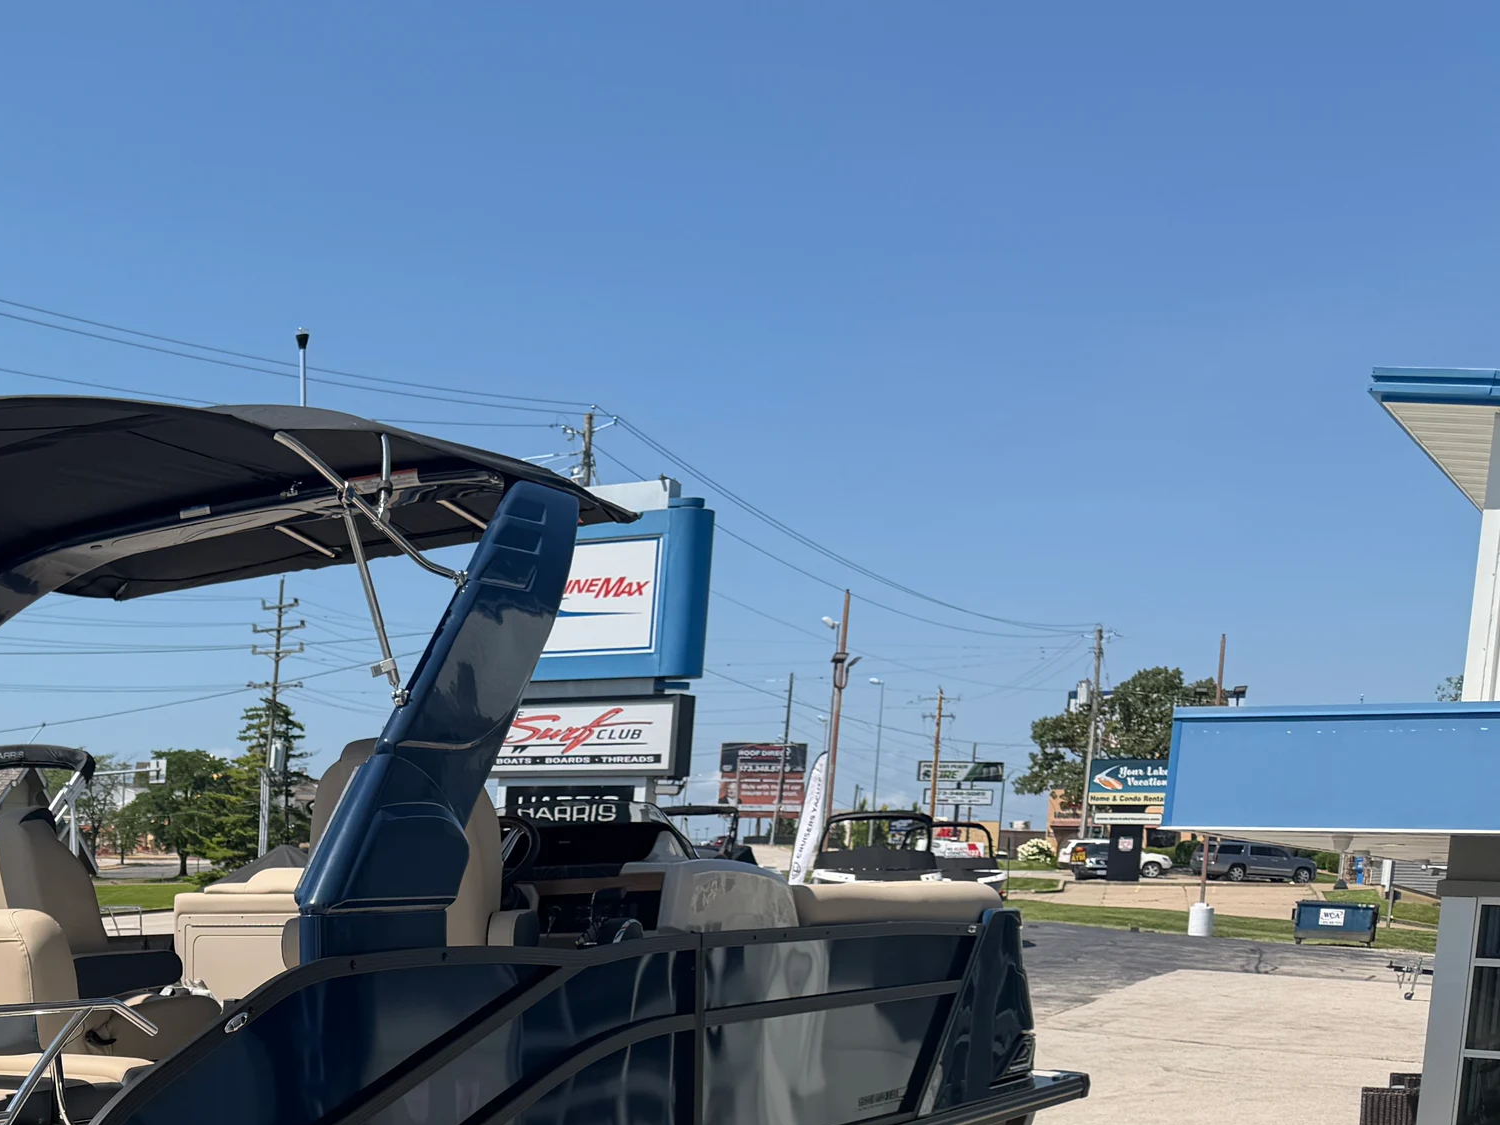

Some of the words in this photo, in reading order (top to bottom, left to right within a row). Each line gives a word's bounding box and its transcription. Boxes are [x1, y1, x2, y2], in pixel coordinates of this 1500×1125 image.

[564, 577, 650, 598] INEMAX
[504, 707, 653, 754] Surf
[596, 729, 643, 740] CLUB
[1118, 767, 1145, 778] Your
